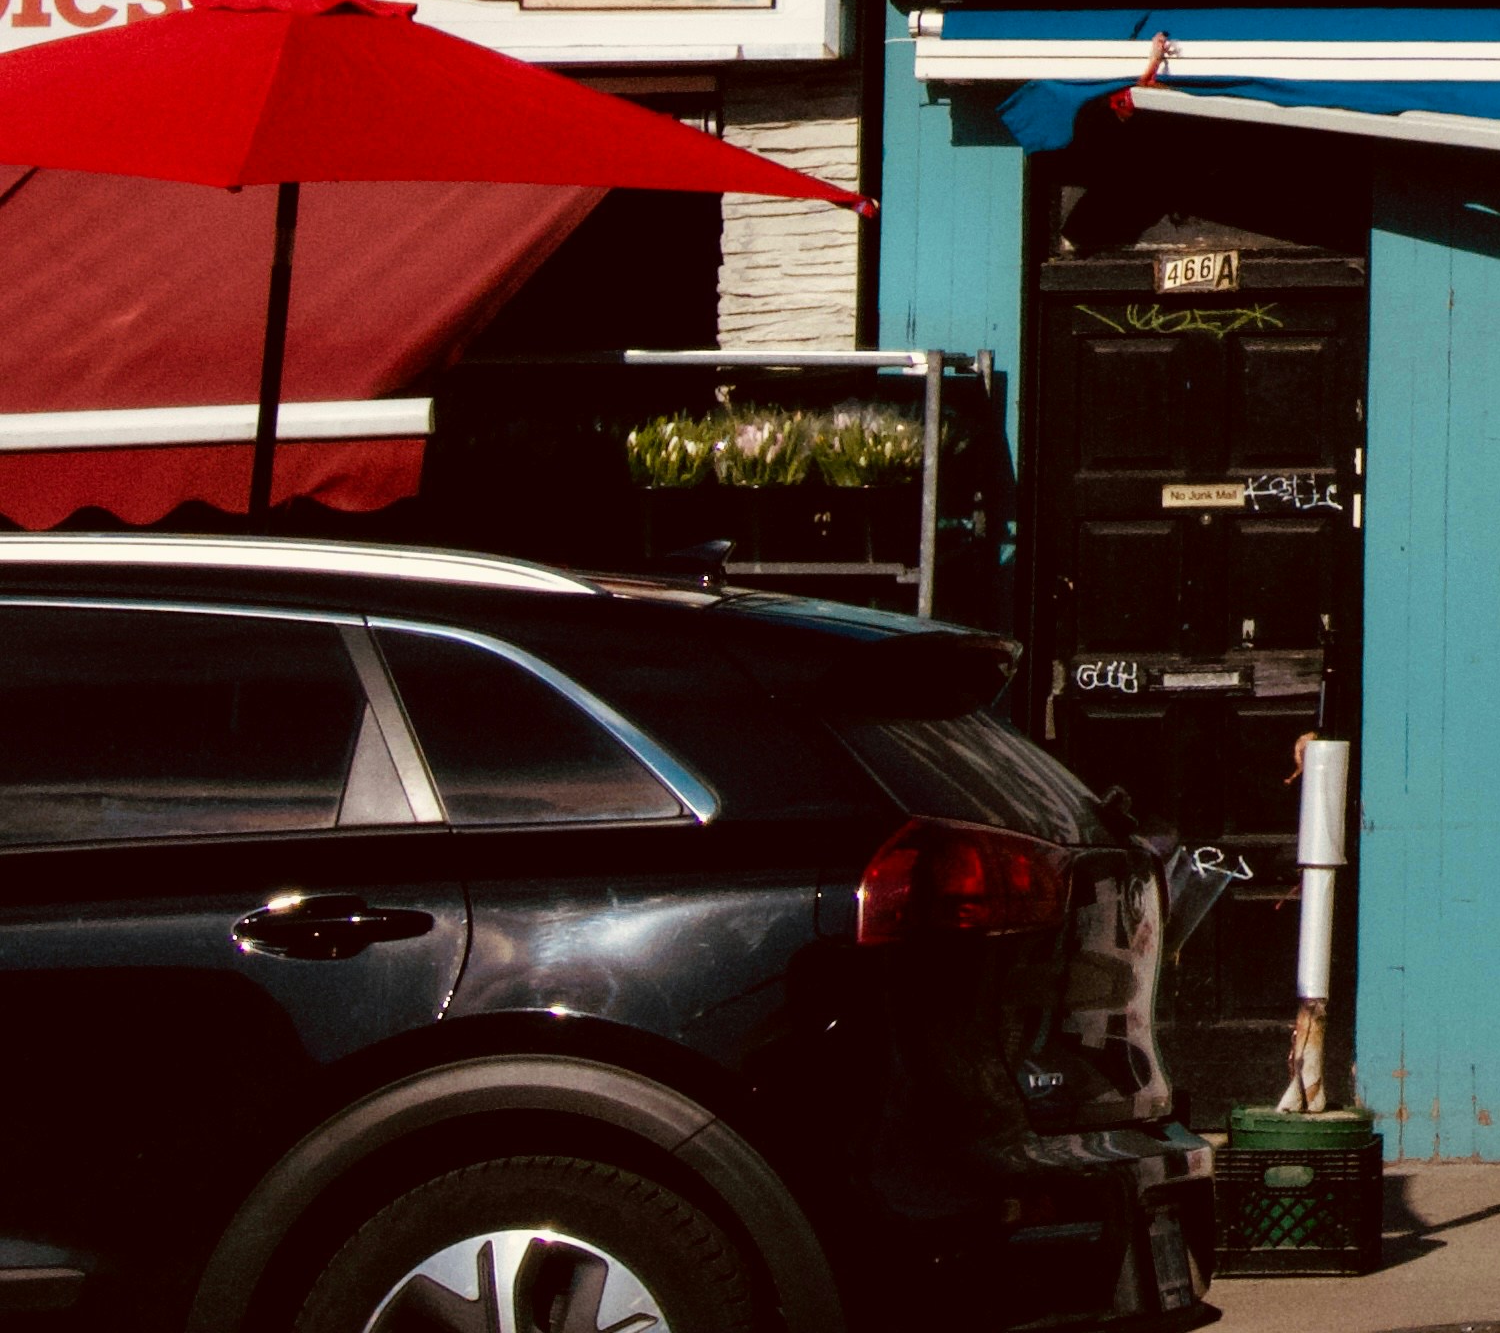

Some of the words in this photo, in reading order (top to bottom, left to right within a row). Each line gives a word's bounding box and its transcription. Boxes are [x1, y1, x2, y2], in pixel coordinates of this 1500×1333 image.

[1167, 253, 1236, 288] 466A
[1170, 490, 1186, 501] No
[1188, 490, 1212, 501] Junk
[1215, 489, 1238, 501] Mail
